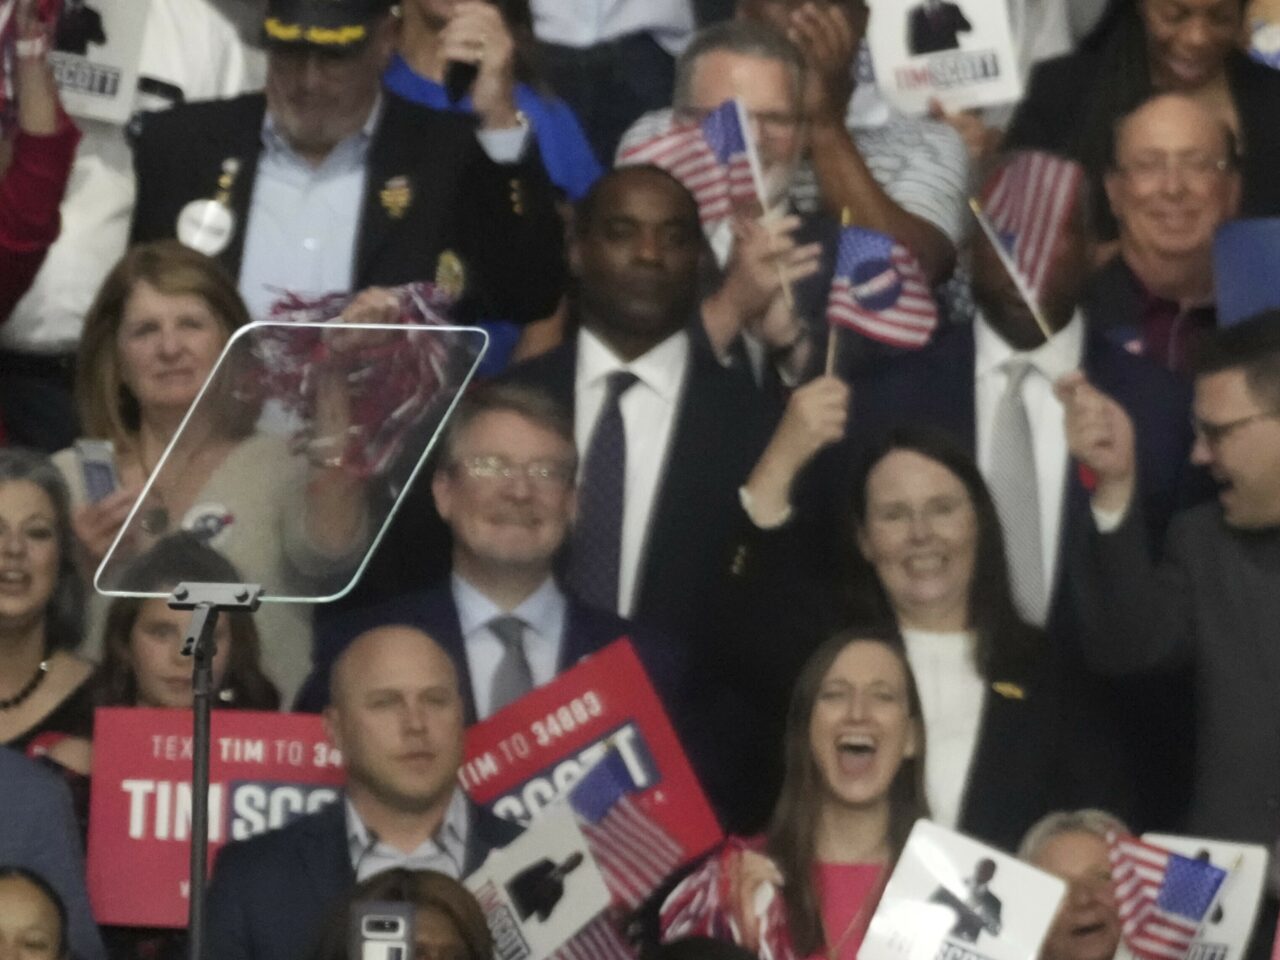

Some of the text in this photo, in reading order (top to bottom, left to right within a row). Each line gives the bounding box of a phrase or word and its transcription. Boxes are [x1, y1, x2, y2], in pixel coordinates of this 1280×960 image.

[151, 734, 195, 761] TEX
[219, 736, 265, 764] TIM
[275, 739, 304, 766] TO
[498, 732, 530, 764] TO
[121, 778, 224, 843] TIM
